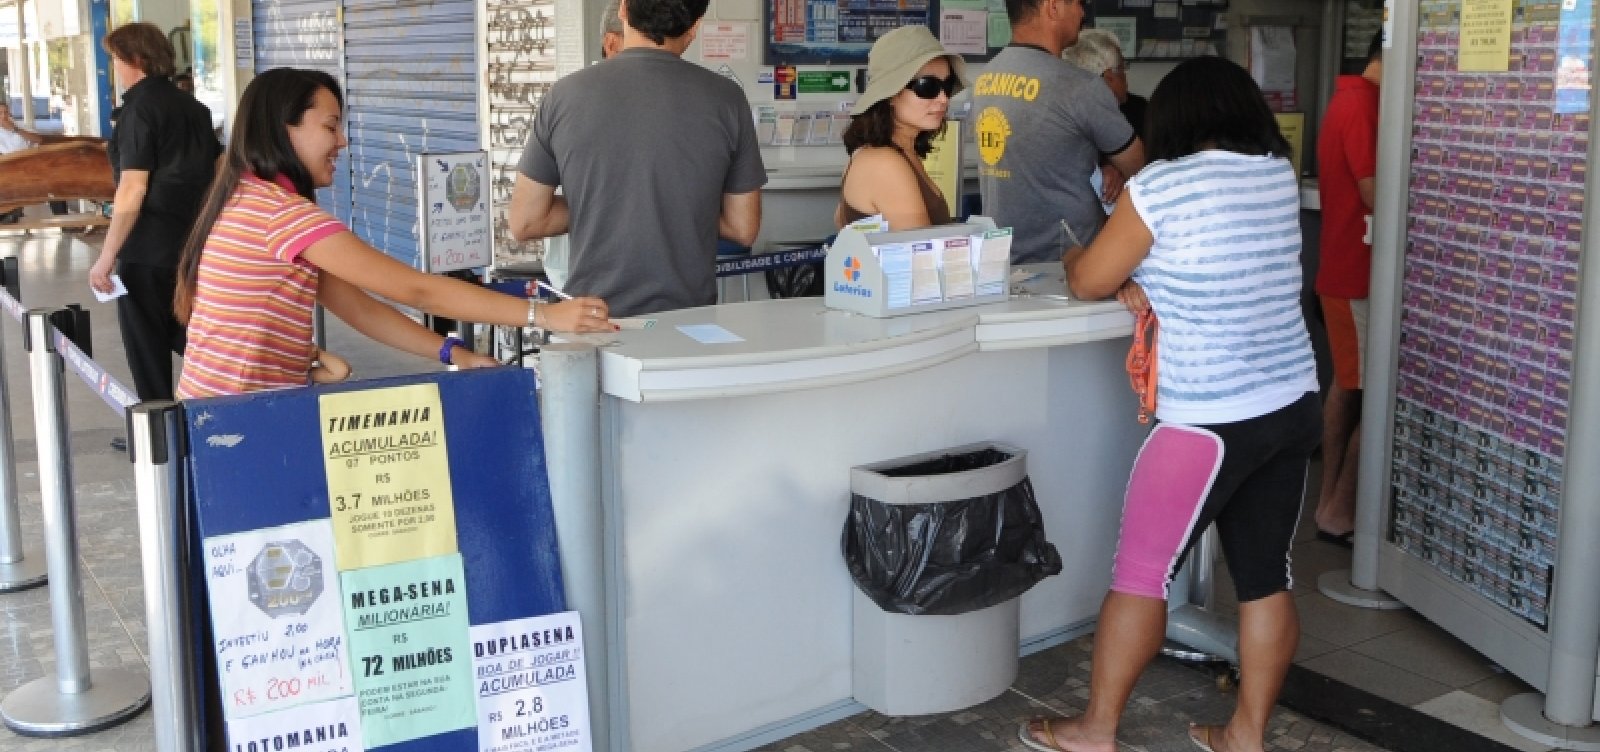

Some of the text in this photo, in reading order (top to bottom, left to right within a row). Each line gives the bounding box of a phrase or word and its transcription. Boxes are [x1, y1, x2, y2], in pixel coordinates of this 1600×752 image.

[833, 282, 873, 298] Loterias
[329, 406, 431, 433] TIMEMANIA
[329, 430, 438, 457] ACUMULADA!
[369, 450, 421, 466] PONTOS
[371, 488, 431, 506] MILHÕES
[352, 578, 456, 609] MEGA-SENA
[473, 624, 575, 658] DUPLASENA
[241, 645, 295, 670] GANHOU
[361, 646, 453, 678] 72 MILHÕES
[267, 676, 301, 700] 200
[479, 663, 576, 697] ACUMULADA
[501, 714, 570, 740] MILHÕES
